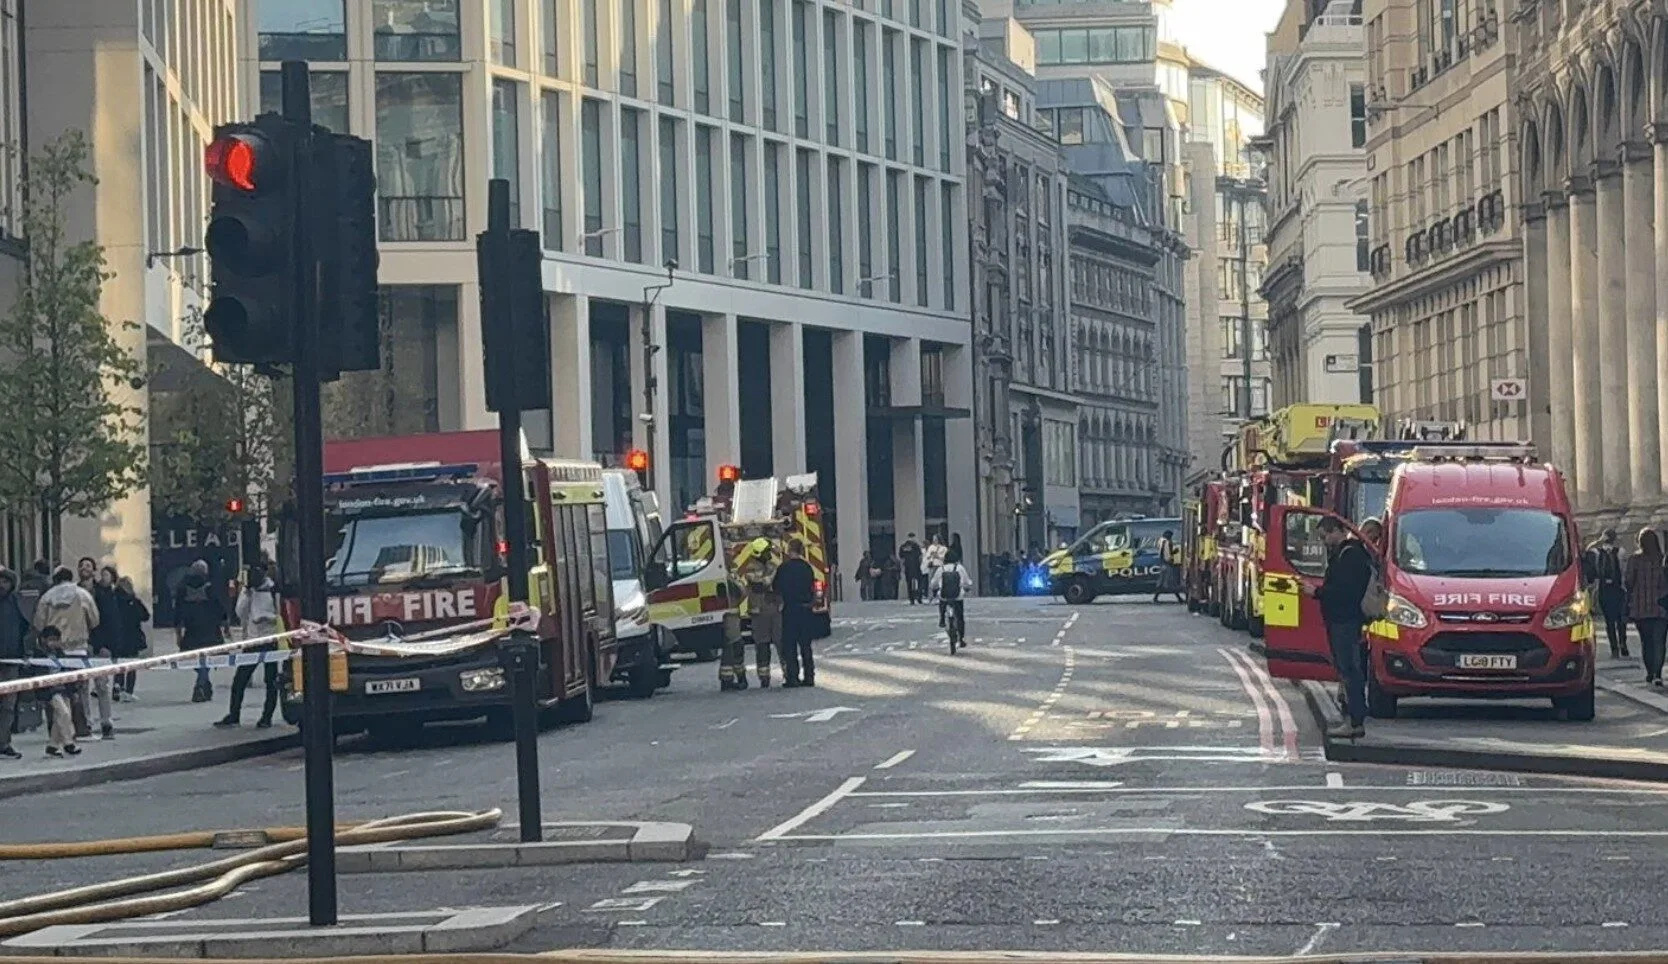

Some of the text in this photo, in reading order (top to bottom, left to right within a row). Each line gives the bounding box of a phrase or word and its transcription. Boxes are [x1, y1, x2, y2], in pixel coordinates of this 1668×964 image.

[1108, 565, 1164, 578] POLIC
[403, 589, 477, 621] FIRE
[1489, 593, 1537, 607] FIRE
